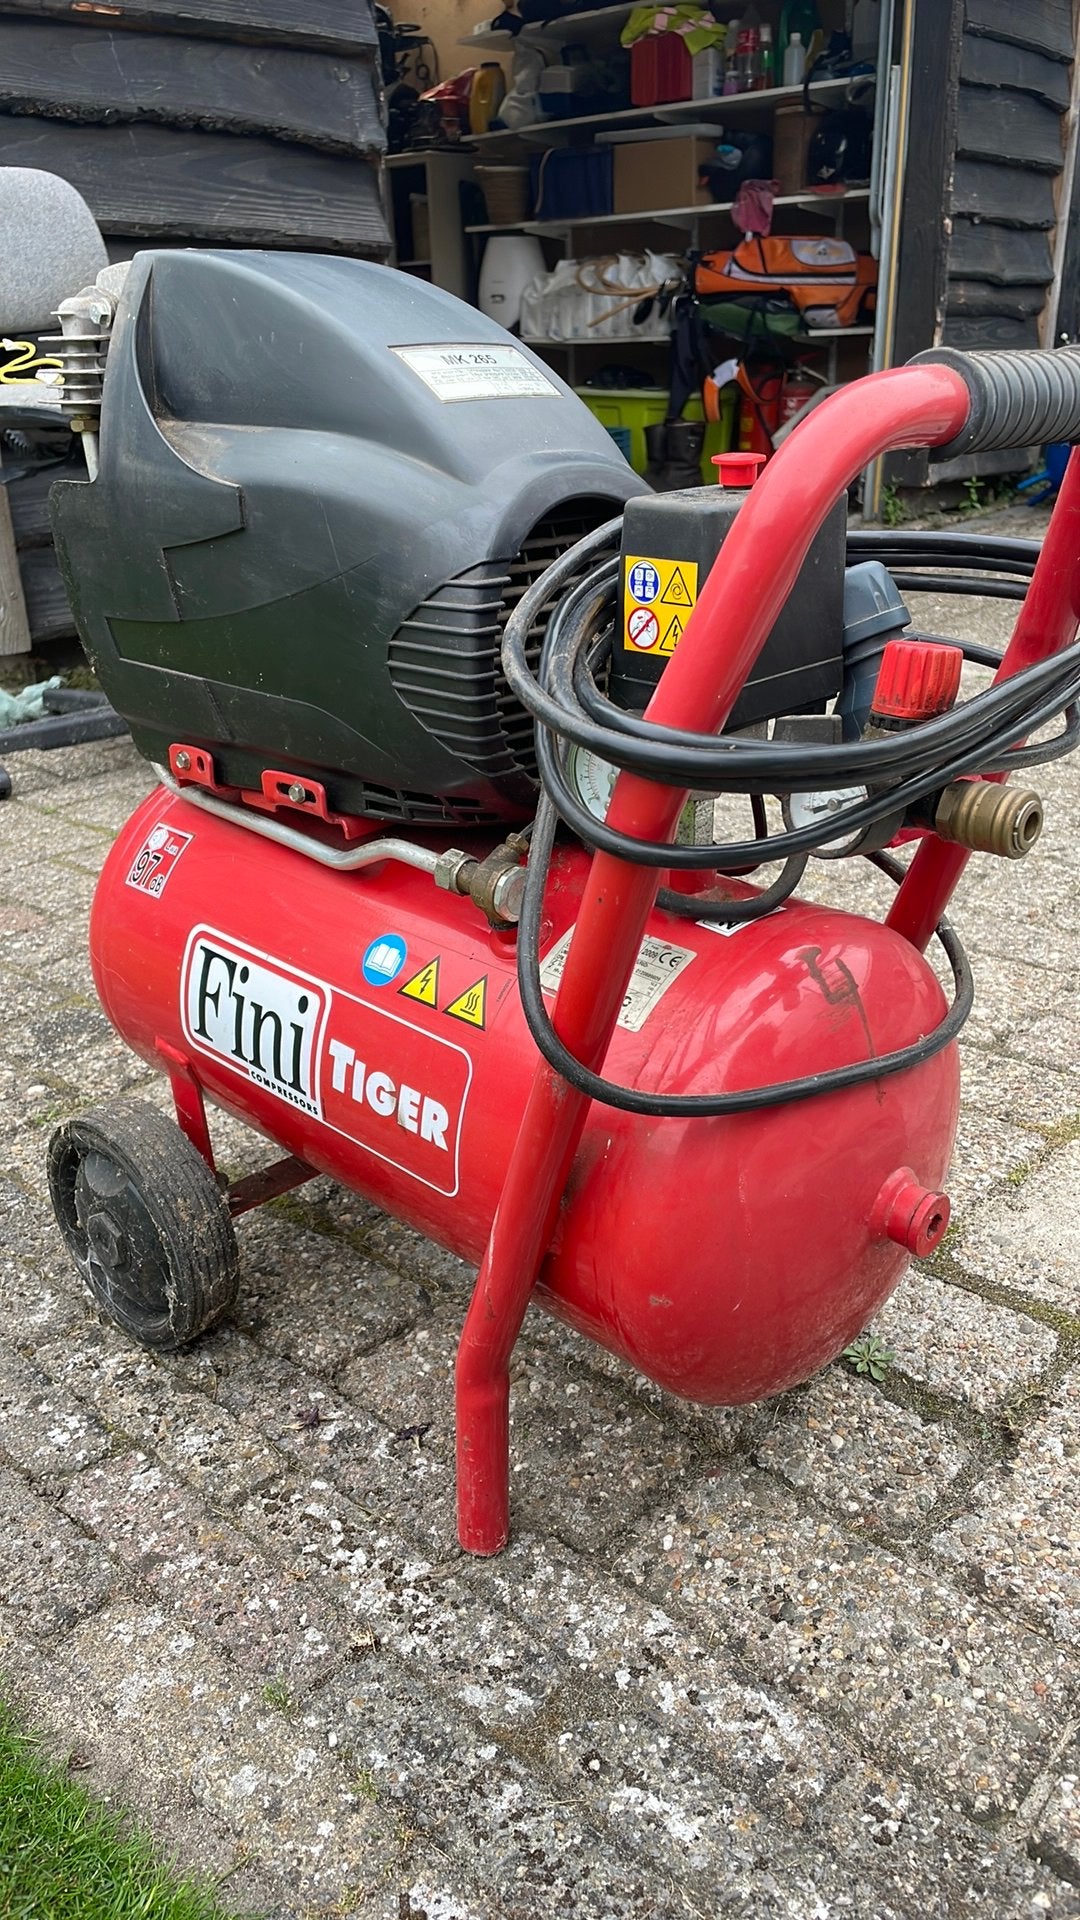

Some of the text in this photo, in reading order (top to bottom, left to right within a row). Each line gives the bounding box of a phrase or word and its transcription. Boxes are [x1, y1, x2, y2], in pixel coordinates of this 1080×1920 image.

[440, 353, 497, 366] MK 265
[132, 851, 162, 886] 97
[641, 948, 659, 960] 2009
[193, 945, 309, 1097] Fini
[250, 1069, 319, 1117] COMPRESSORS
[328, 1037, 449, 1152] TIGER
